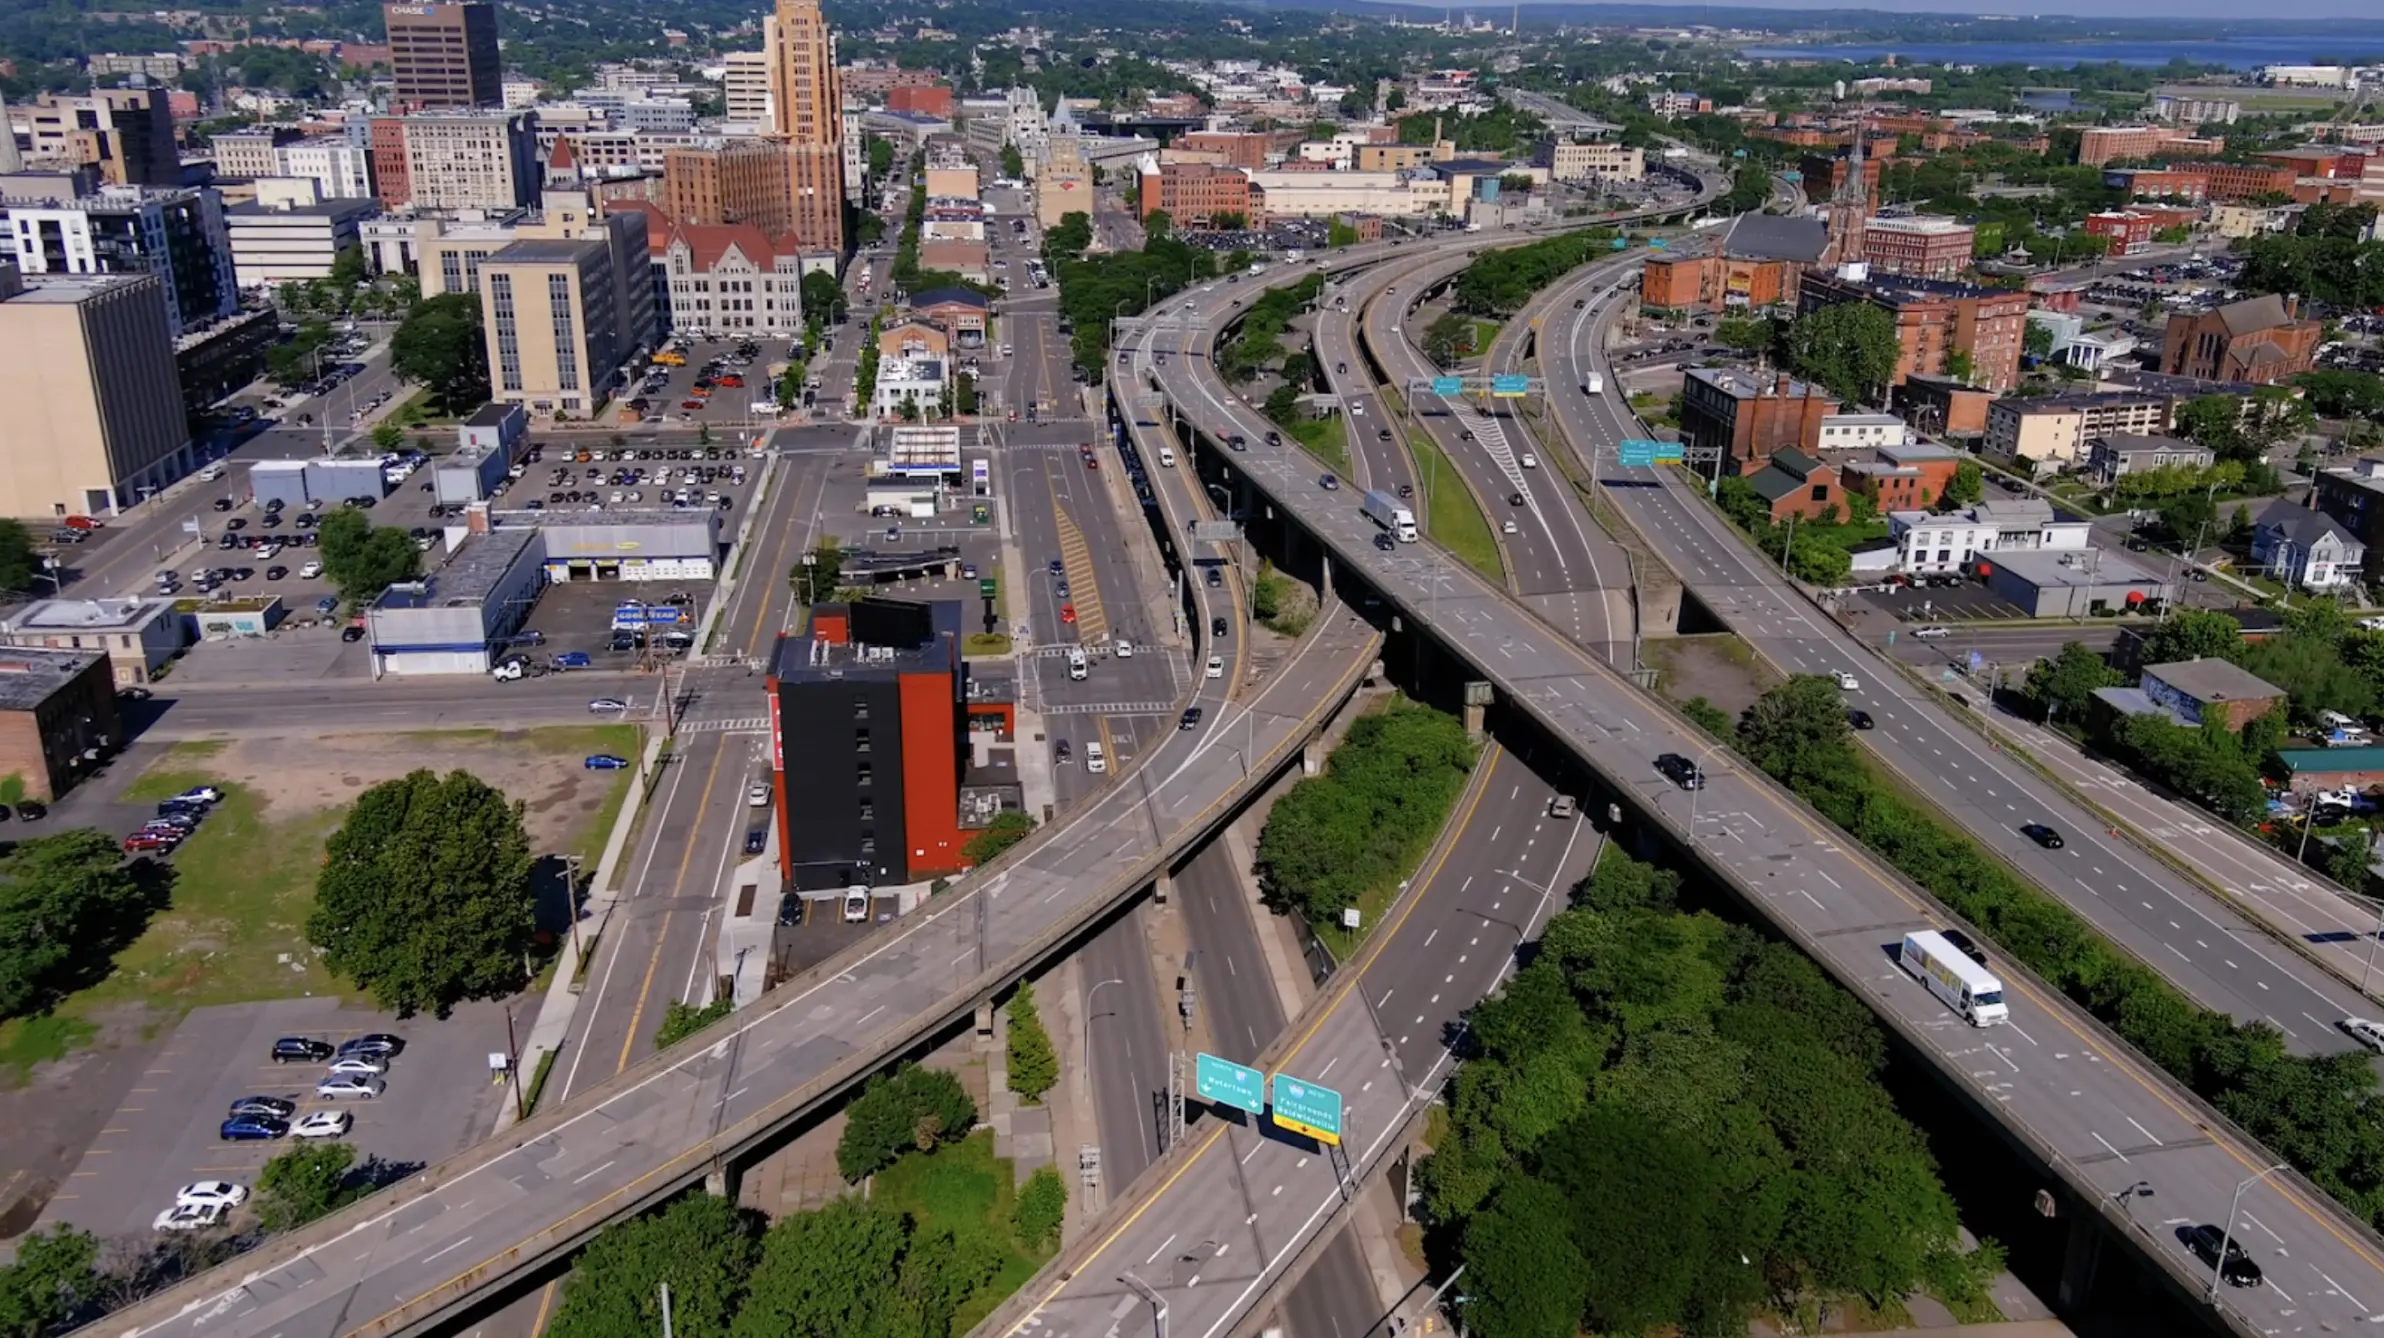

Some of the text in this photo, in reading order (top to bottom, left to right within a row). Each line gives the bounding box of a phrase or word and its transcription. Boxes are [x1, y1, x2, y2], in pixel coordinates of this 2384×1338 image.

[392, 6, 424, 14] CHASE
[1208, 1076, 1253, 1097] Watertown
[1276, 1105, 1337, 1131] Baldwinsville
[1279, 1097, 1333, 1121] Fairgrounds
